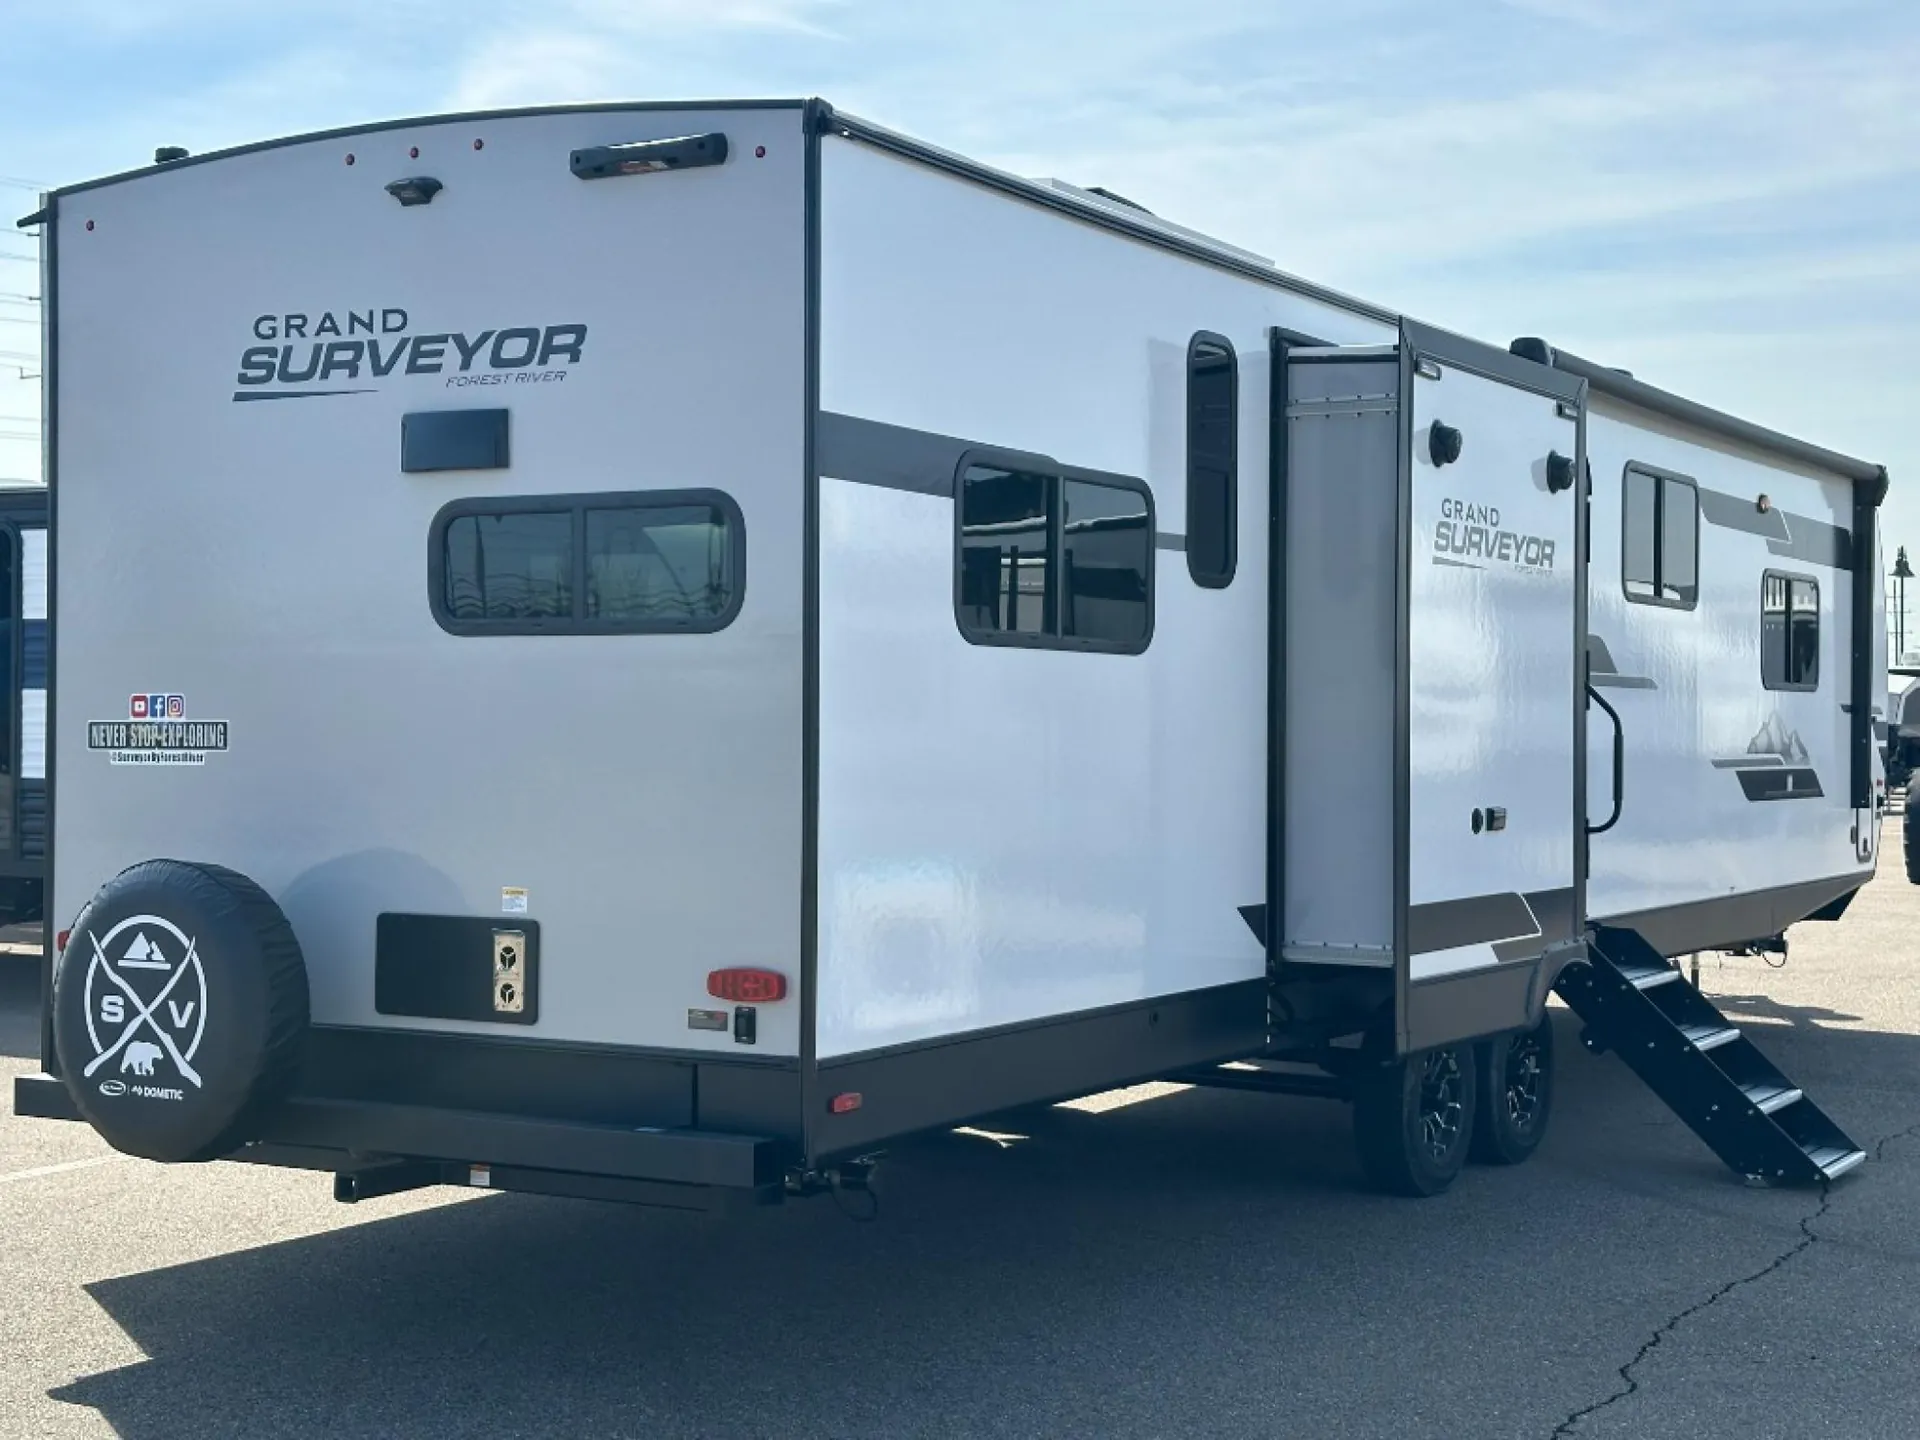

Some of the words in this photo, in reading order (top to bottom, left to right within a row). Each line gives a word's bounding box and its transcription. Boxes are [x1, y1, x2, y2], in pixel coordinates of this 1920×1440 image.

[253, 308, 408, 340] GRAND
[237, 324, 588, 385] SURVEYOR
[446, 372, 513, 388] FOREST
[515, 370, 567, 383] RIVER
[1441, 498, 1501, 527] GRAND
[1433, 520, 1555, 568] SURVEYOR
[91, 723, 127, 747] NEVER
[131, 723, 159, 747] STOP
[162, 723, 224, 747] EXPLORING
[101, 995, 125, 1023] S
[168, 1000, 196, 1028] V
[144, 1086, 184, 1100] DOMETIC
